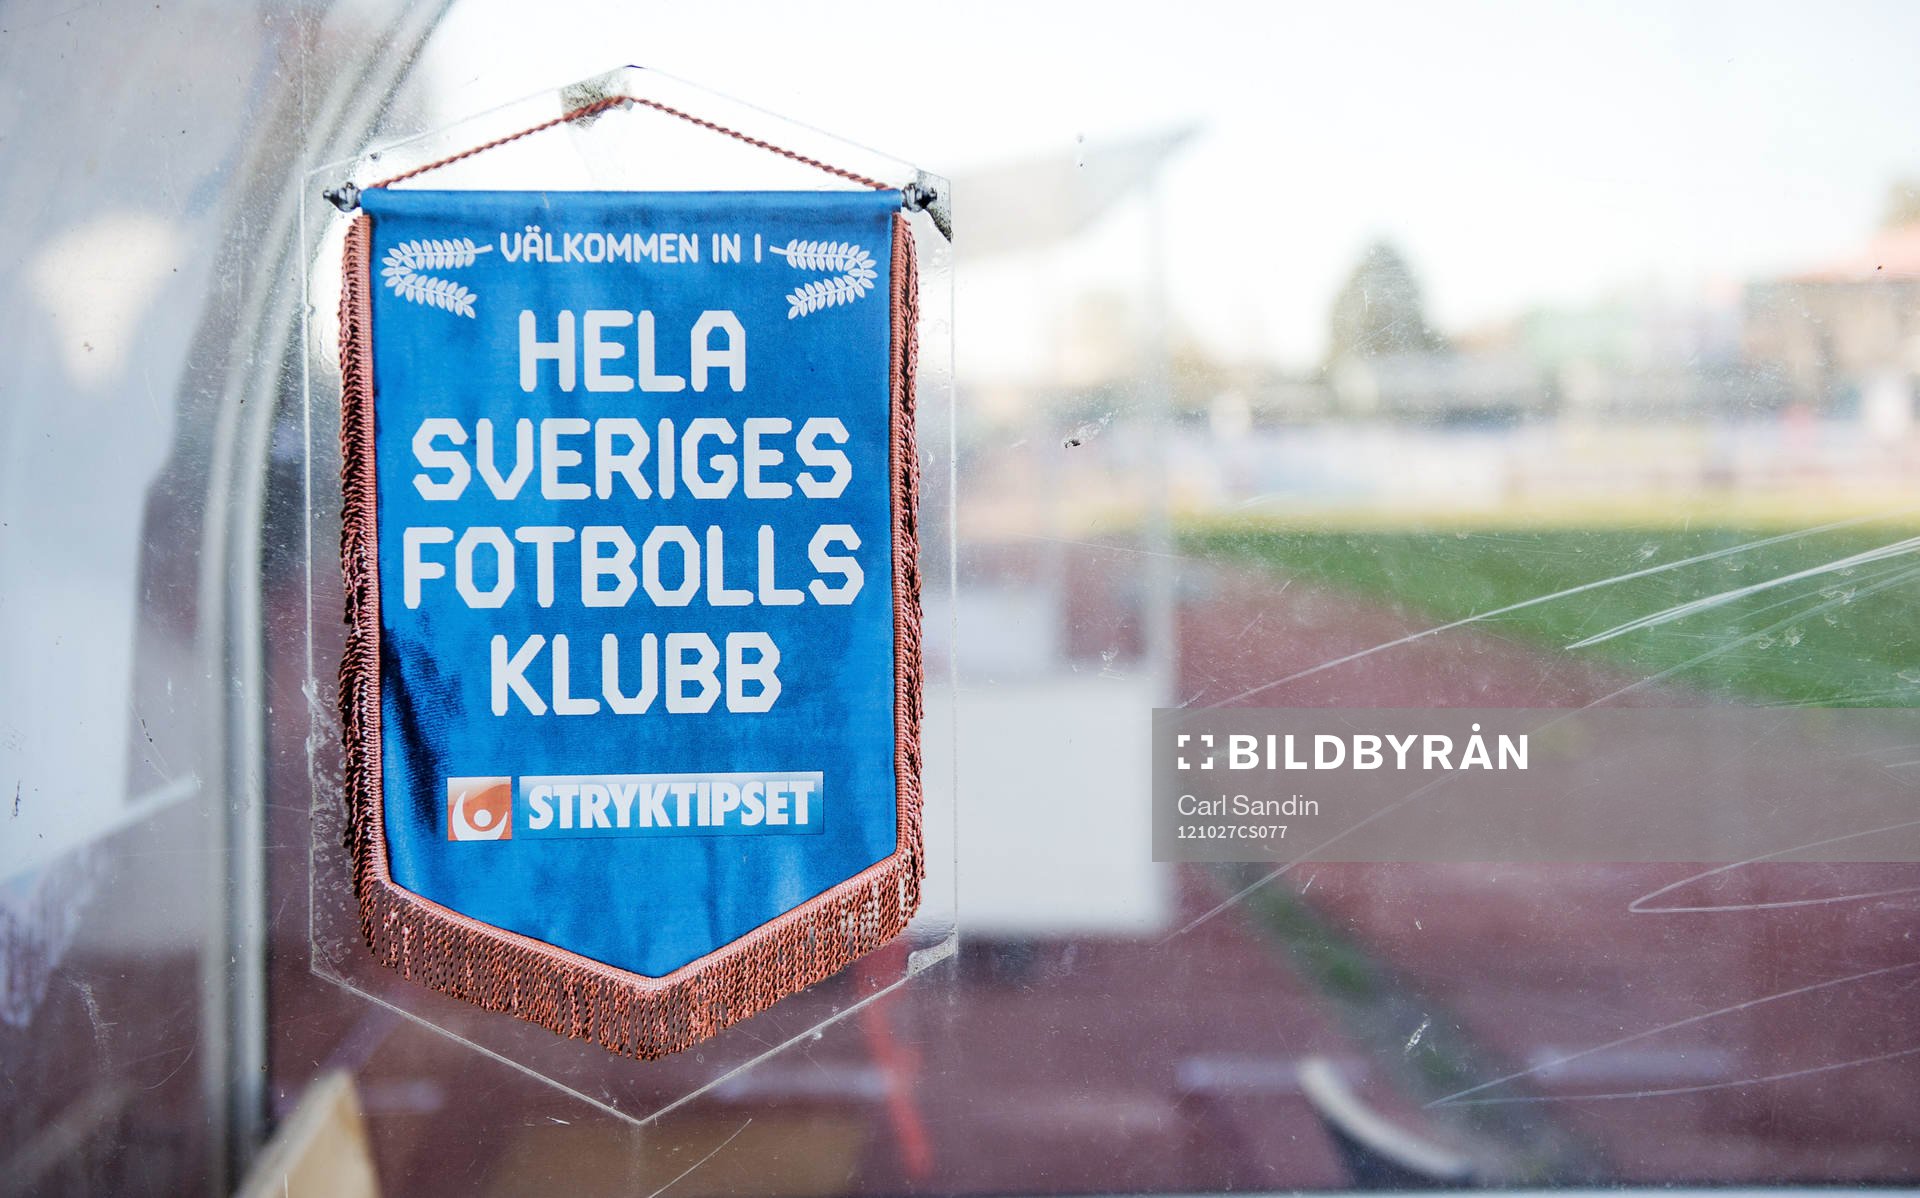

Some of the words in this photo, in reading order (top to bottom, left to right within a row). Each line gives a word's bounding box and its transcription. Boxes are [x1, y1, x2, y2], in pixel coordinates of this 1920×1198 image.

[500, 225, 700, 264] VÄLKOMMEN
[712, 232, 742, 264] IN
[754, 232, 762, 264] I
[518, 309, 746, 393] HELA
[411, 416, 852, 501] SVERIGES
[402, 523, 865, 609] FOTBOLLS
[490, 631, 782, 716] KLUBB
[527, 780, 816, 830] STRYKTIPSET
